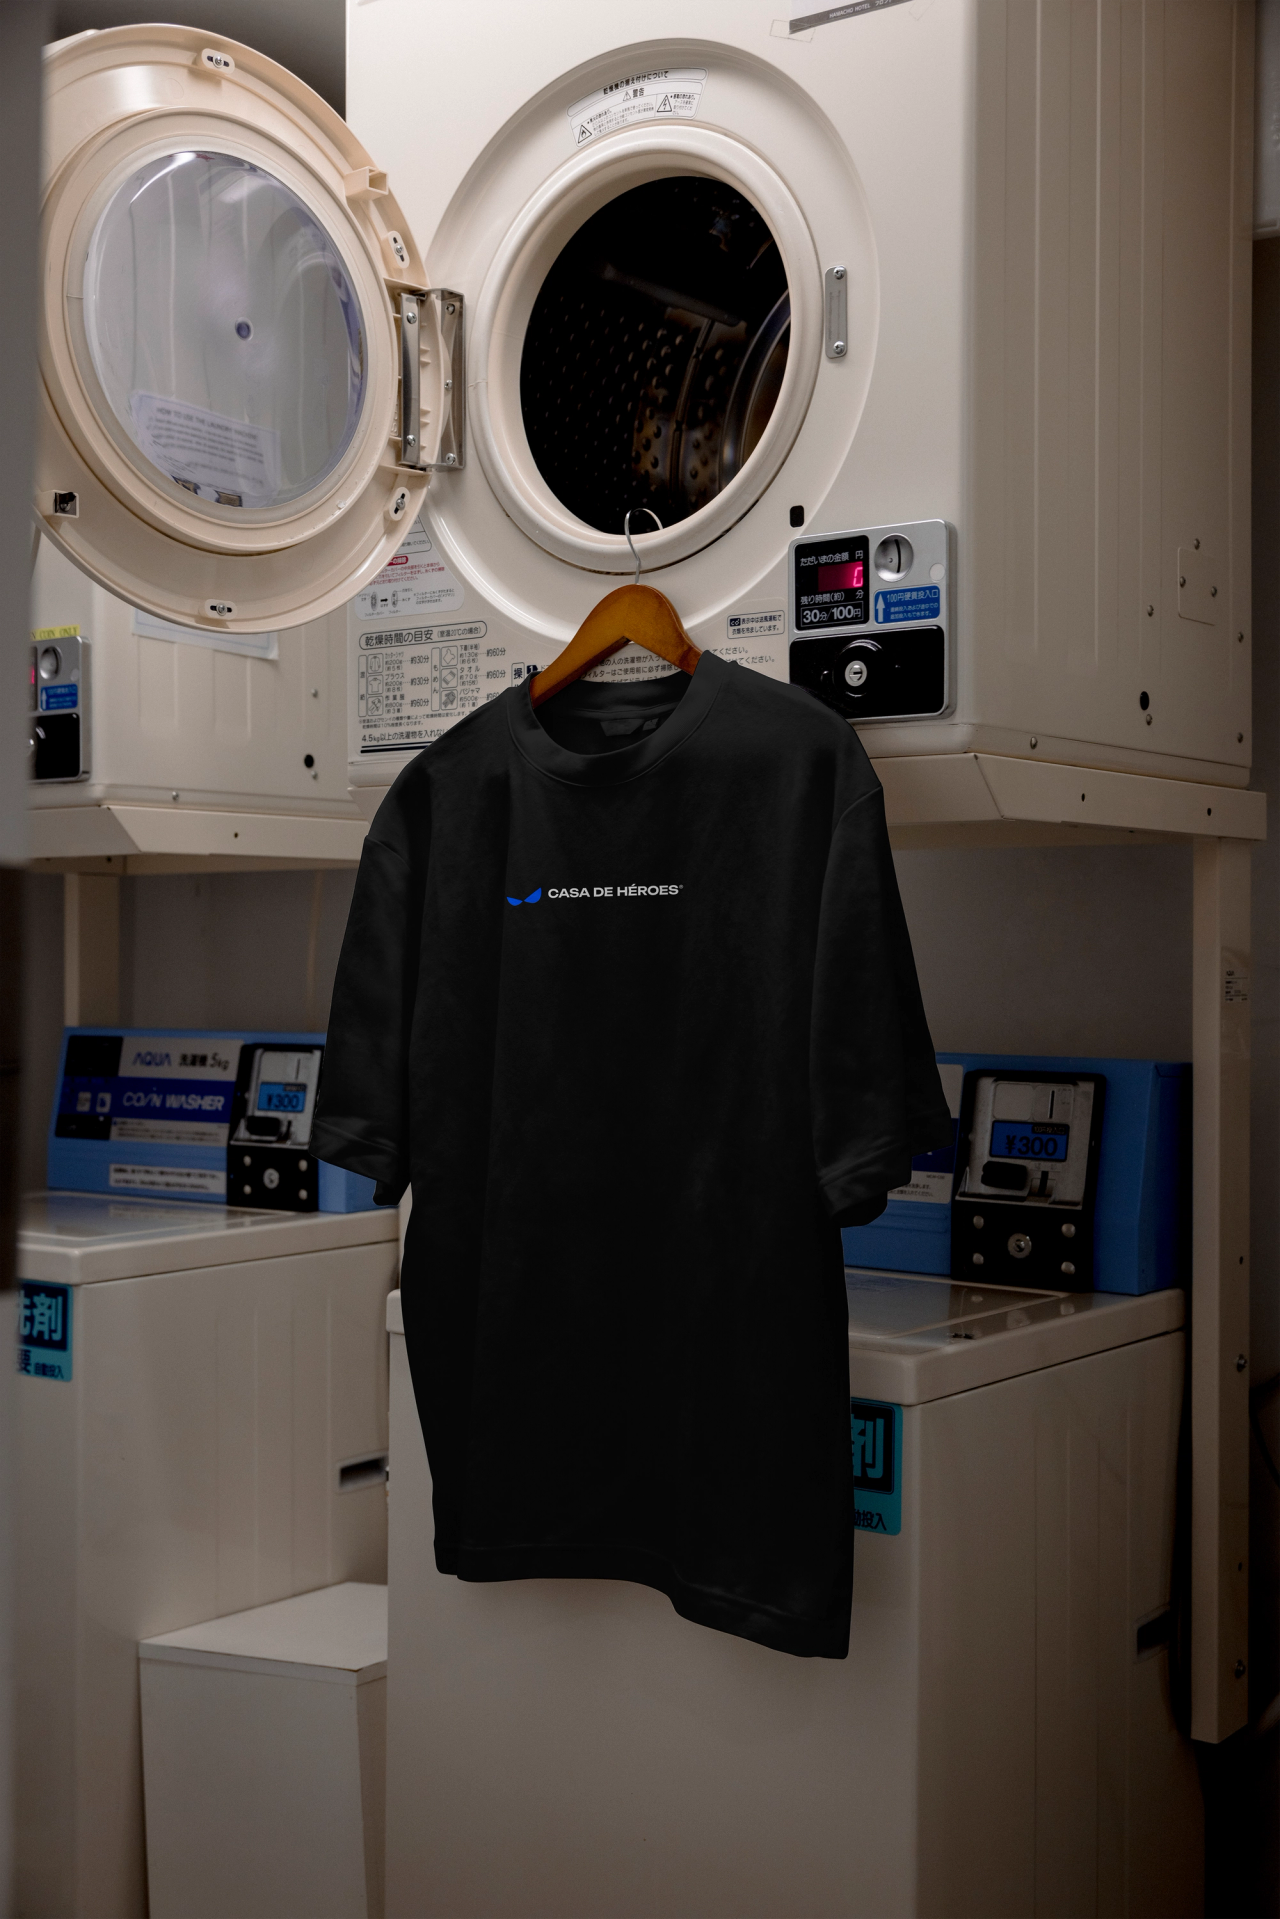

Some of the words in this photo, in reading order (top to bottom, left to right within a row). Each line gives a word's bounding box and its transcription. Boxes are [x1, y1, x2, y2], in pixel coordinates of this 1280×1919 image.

[854, 4, 871, 12] HOTEL
[800, 552, 850, 567] ただいまの金額
[856, 550, 864, 559] 円
[800, 591, 845, 605] 残り時間(約)
[856, 590, 864, 599] 分
[886, 590, 938, 603] 100円硬貨投入口
[803, 606, 861, 623] 30分/100円
[365, 629, 433, 648] 乾燥時間の目安
[411, 655, 429, 664] 約30分
[486, 648, 506, 657] 約60分
[411, 676, 429, 686] 約30分
[486, 670, 506, 679] 約60分
[548, 888, 590, 898] CASA
[593, 887, 613, 897] DE
[132, 1052, 172, 1067] AQUA
[210, 1052, 230, 1070] 5kg
[166, 1093, 225, 1112] WASHER
[1005, 1135, 1058, 1156] ¥300
